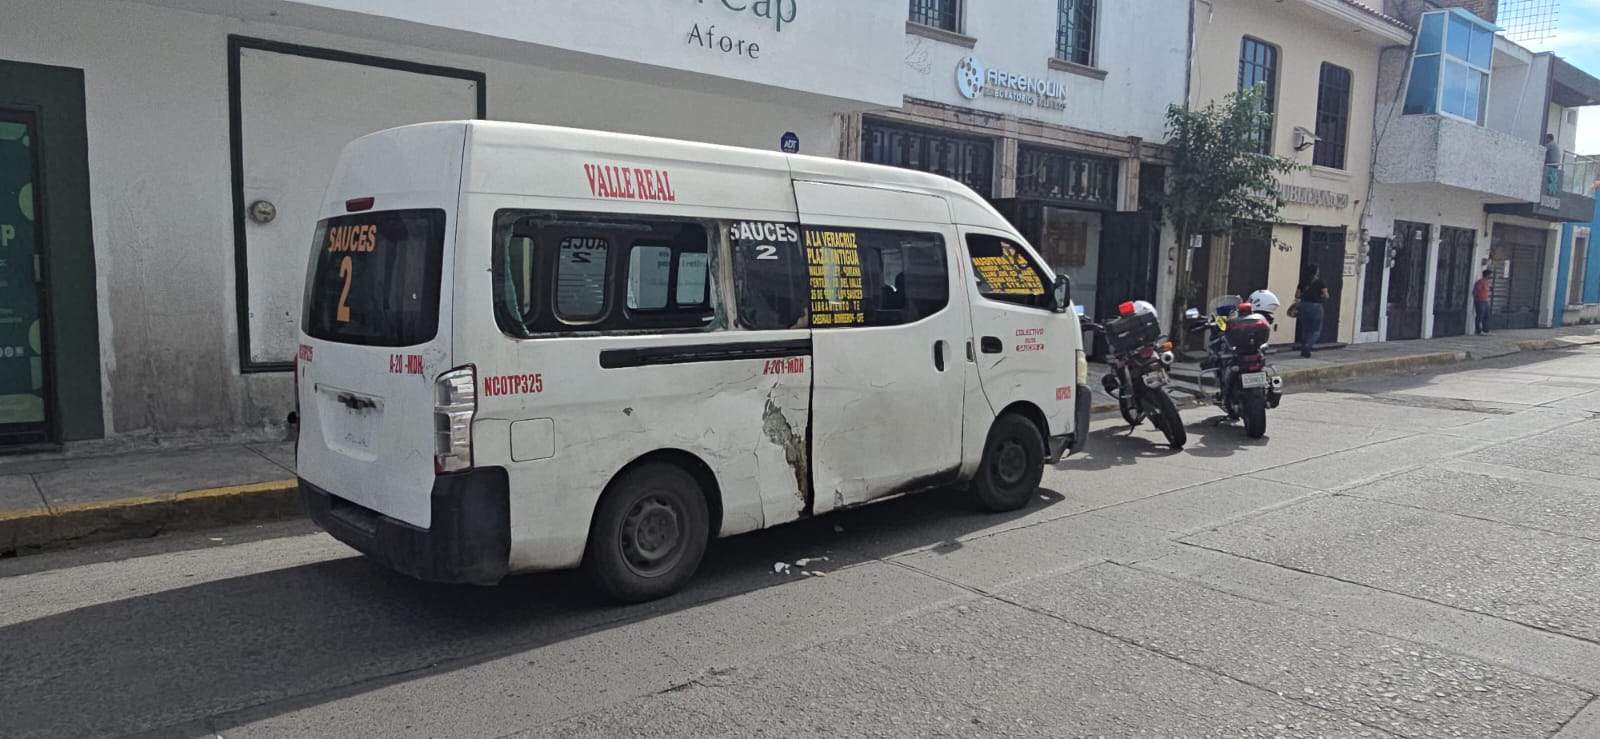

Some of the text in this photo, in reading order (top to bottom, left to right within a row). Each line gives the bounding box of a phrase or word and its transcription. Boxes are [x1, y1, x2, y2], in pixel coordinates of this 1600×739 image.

[687, 23, 760, 59] Afore
[784, 139, 797, 149] ADT
[583, 163, 675, 202] VALLE REAL
[328, 223, 377, 253] SAUCES
[730, 221, 798, 243] SAUCES
[806, 230, 858, 249] A LA VERACRUZ
[756, 244, 779, 260] 2
[807, 247, 860, 266] PLAZA ANTIGUA
[336, 255, 353, 322] 2
[811, 300, 850, 312] LIBRAMIENTO
[1015, 328, 1044, 337] COLECTIVO
[484, 373, 543, 397] NCOTP325
